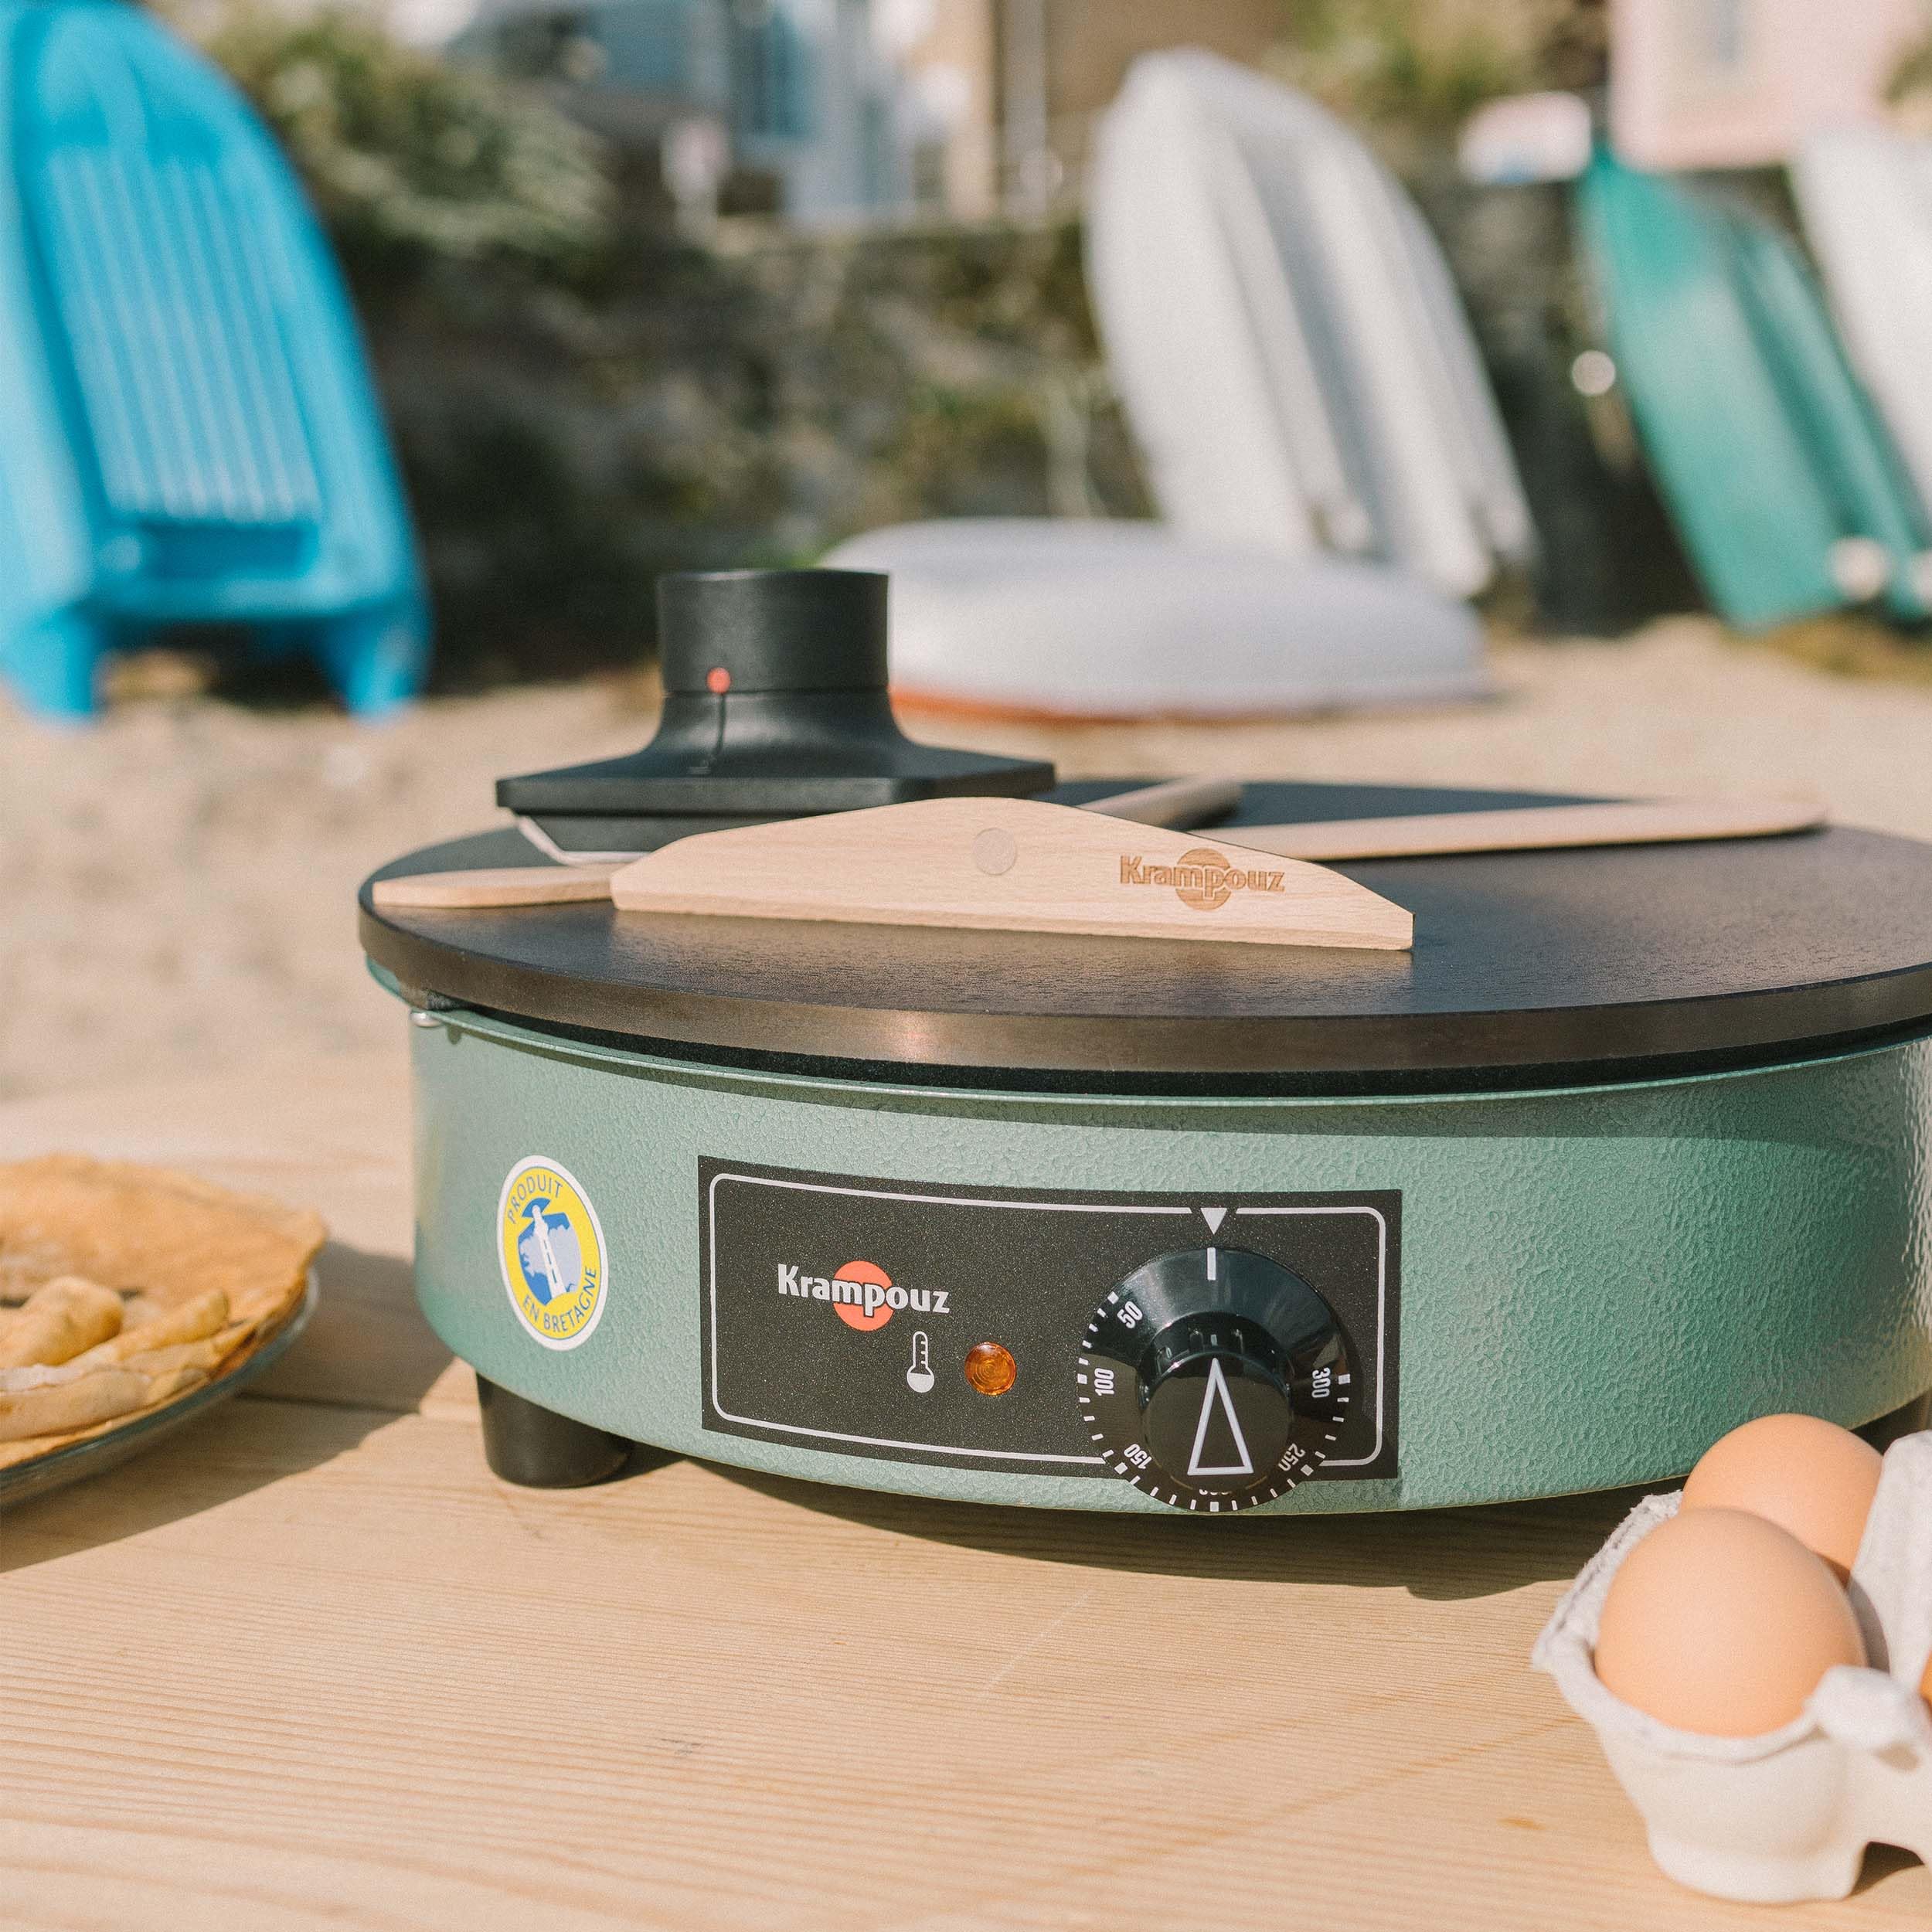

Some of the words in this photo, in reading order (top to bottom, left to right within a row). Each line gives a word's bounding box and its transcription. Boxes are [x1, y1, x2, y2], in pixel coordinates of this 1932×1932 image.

[1120, 855, 1285, 898] Krampouz
[507, 1174, 563, 1225] PRODUIT
[523, 1294, 540, 1322] EN
[543, 1265, 597, 1333] BRETAGNE
[777, 1263, 951, 1317] Krampouz
[1117, 1301, 1143, 1328] 50
[1094, 1367, 1114, 1396] 100
[1311, 1366, 1332, 1398] 300
[1124, 1444, 1152, 1469] 150
